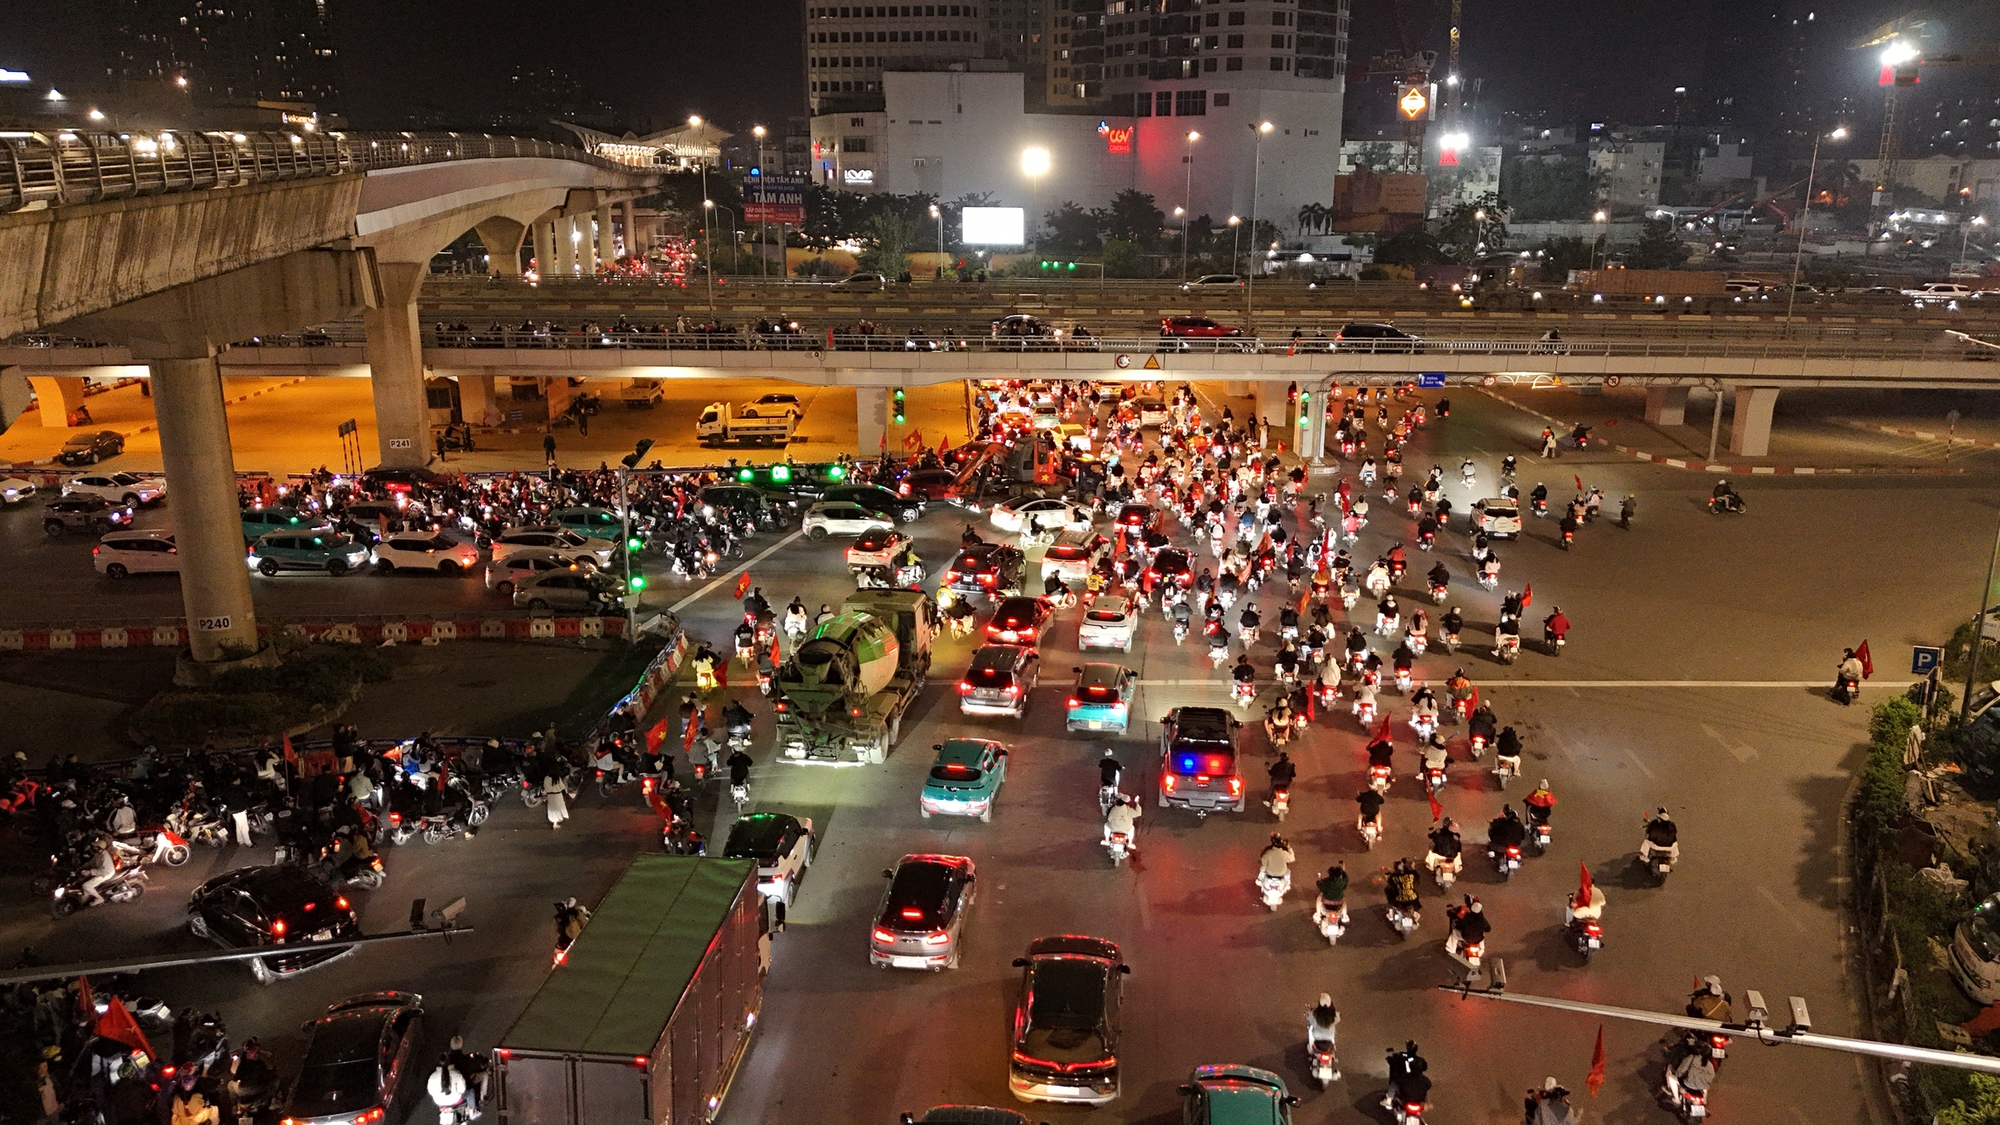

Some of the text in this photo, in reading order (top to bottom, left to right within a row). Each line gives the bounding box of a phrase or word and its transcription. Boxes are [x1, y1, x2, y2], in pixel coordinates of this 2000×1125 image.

[1110, 129, 1130, 143] CGV
[779, 193, 803, 204] ANH
[200, 618, 229, 629] P240
[1918, 653, 1932, 666] P
